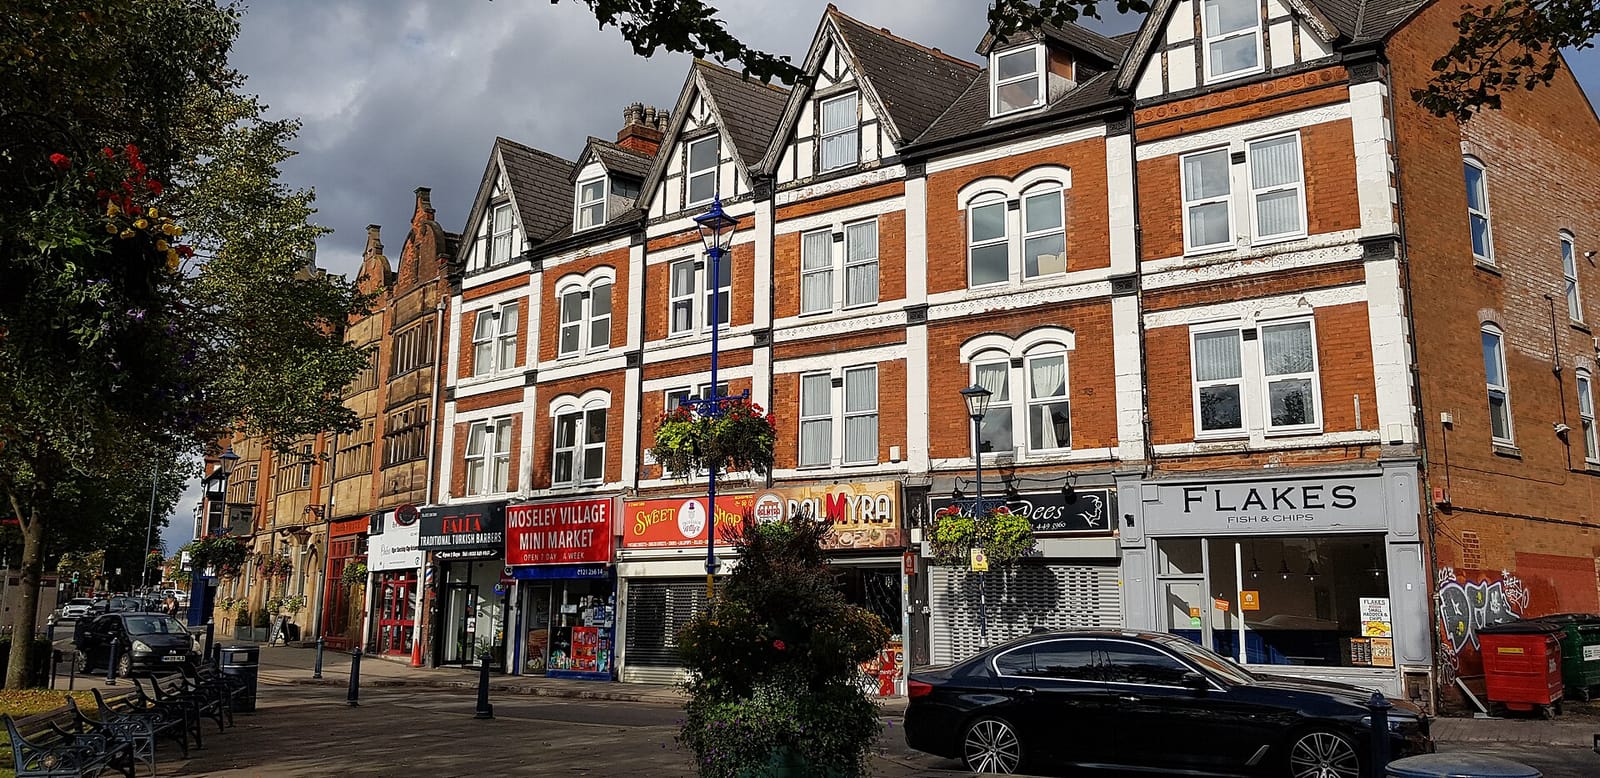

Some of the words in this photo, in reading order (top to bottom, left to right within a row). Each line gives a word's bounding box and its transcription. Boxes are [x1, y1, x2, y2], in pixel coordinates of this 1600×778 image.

[1182, 485, 1357, 513] FLAKES
[508, 507, 557, 528] MOSELEY
[560, 503, 606, 524] VILLAGE
[633, 508, 676, 535] SWEET
[1227, 515, 1257, 524] FISH
[1260, 515, 1270, 523] &
[1272, 513, 1314, 522] CHIPS
[420, 535, 452, 547] TRADITIONAL
[452, 533, 475, 545] TURKISH
[475, 532, 502, 543] BARBERS
[519, 532, 545, 550] MINI
[547, 529, 594, 549] MARKET
[523, 553, 539, 561] OPEN
[562, 552, 567, 560] A
[568, 551, 585, 560] WEEK
